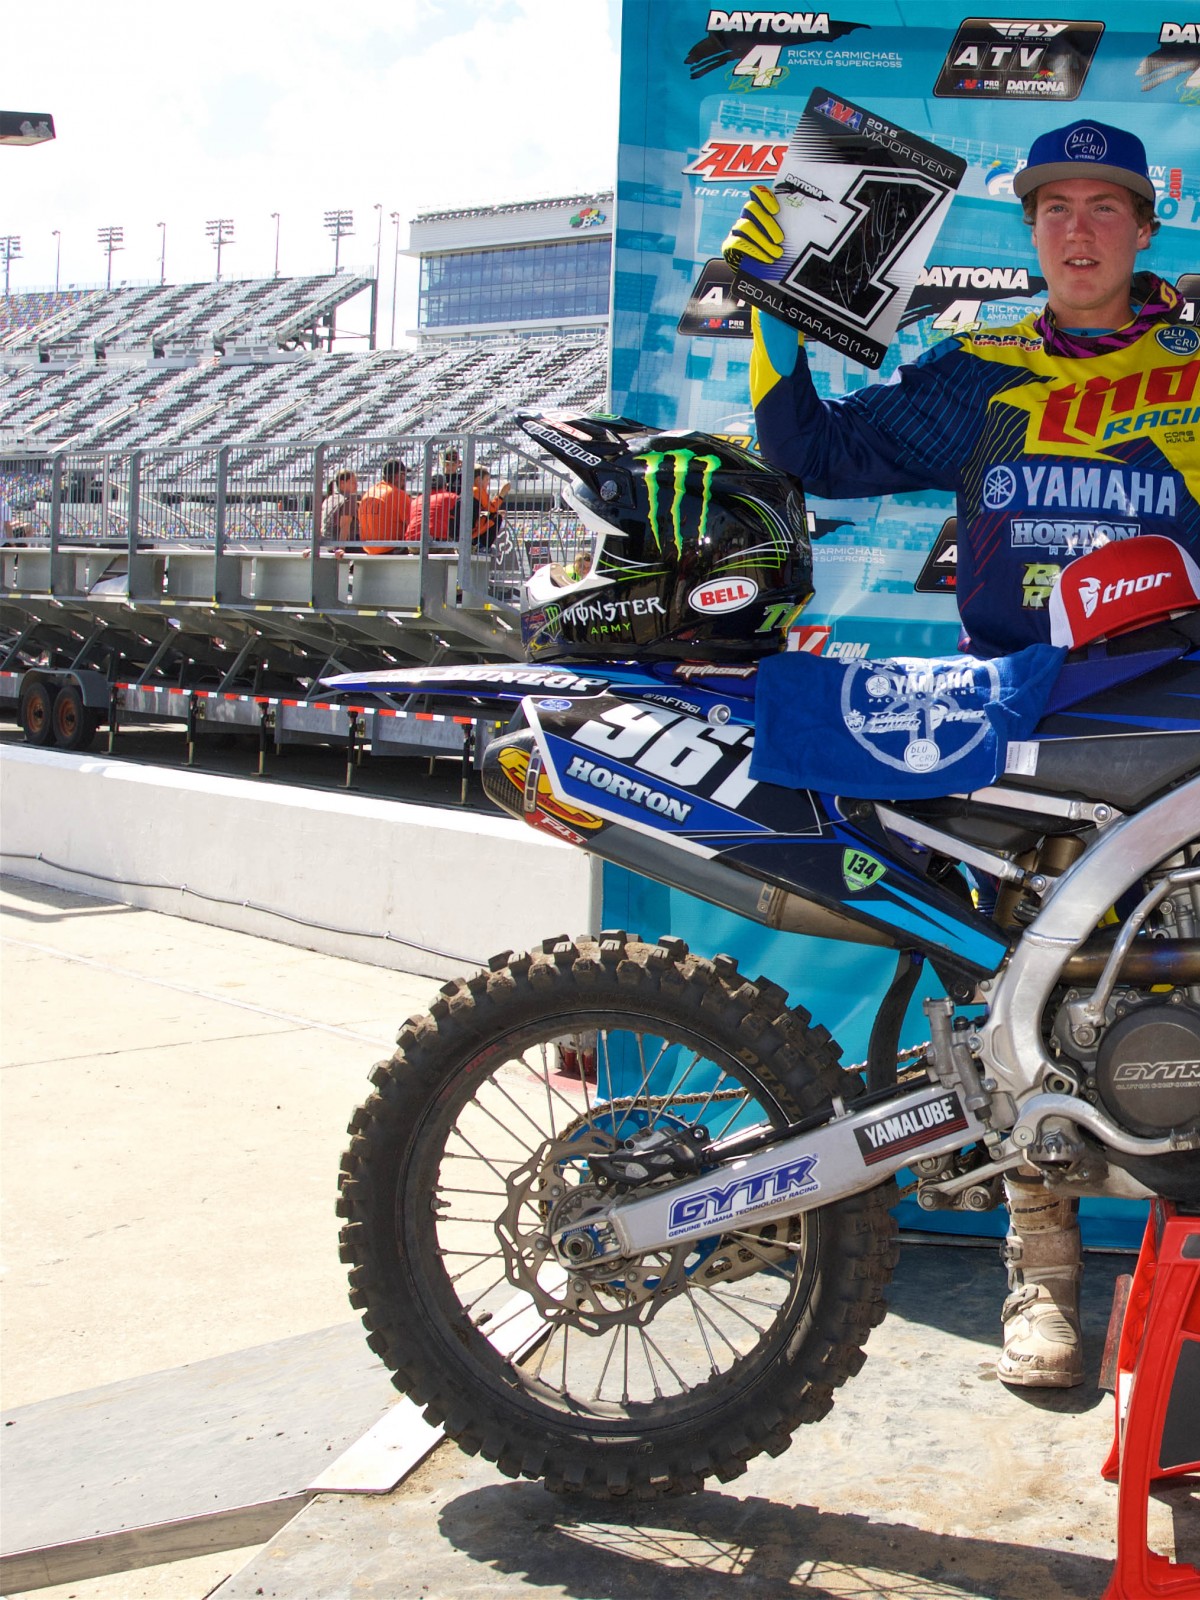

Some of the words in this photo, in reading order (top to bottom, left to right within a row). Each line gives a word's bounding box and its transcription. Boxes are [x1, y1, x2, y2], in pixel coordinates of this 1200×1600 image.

[707, 10, 830, 34] DAYTONA
[989, 22, 1069, 37] FLY
[733, 44, 783, 88] 4
[788, 50, 822, 59] RICKY
[825, 50, 903, 61] CARMICHAEL
[835, 59, 902, 68] SUPERCROSS
[1006, 80, 1065, 91] DAYTONA
[814, 97, 863, 130] AMA
[867, 117, 898, 138] 2016
[692, 142, 789, 178] AMS
[861, 128, 911, 158] MAJOR
[909, 152, 957, 181] EVENT
[694, 187, 718, 197] The
[722, 187, 750, 197] Firs
[786, 174, 823, 199] DAYTONA
[737, 280, 763, 300] 250
[762, 292, 822, 332] ALL-STAR
[821, 323, 849, 347] A/B
[987, 305, 1022, 313] RICKY
[974, 334, 1044, 346] PARTS
[1022, 466, 1176, 516] YAMAHA
[1012, 521, 1139, 546] HORTON
[813, 548, 887, 557] CARMICHAEL
[820, 556, 886, 564] SUPERCROSS
[700, 585, 749, 606] BELL
[1102, 572, 1172, 604] thor
[590, 623, 631, 635] ARMY
[894, 669, 975, 695] YAMAHA
[566, 756, 693, 823] HORTON
[847, 854, 878, 879] 134
[866, 1098, 955, 1149] YAMALUBE
[668, 1156, 818, 1230] GYTR
[668, 1225, 701, 1238] GENUINE
[702, 1211, 734, 1228] YAMAHA
[735, 1195, 787, 1216] TECHNOLOGY
[788, 1184, 819, 1199] RACING
